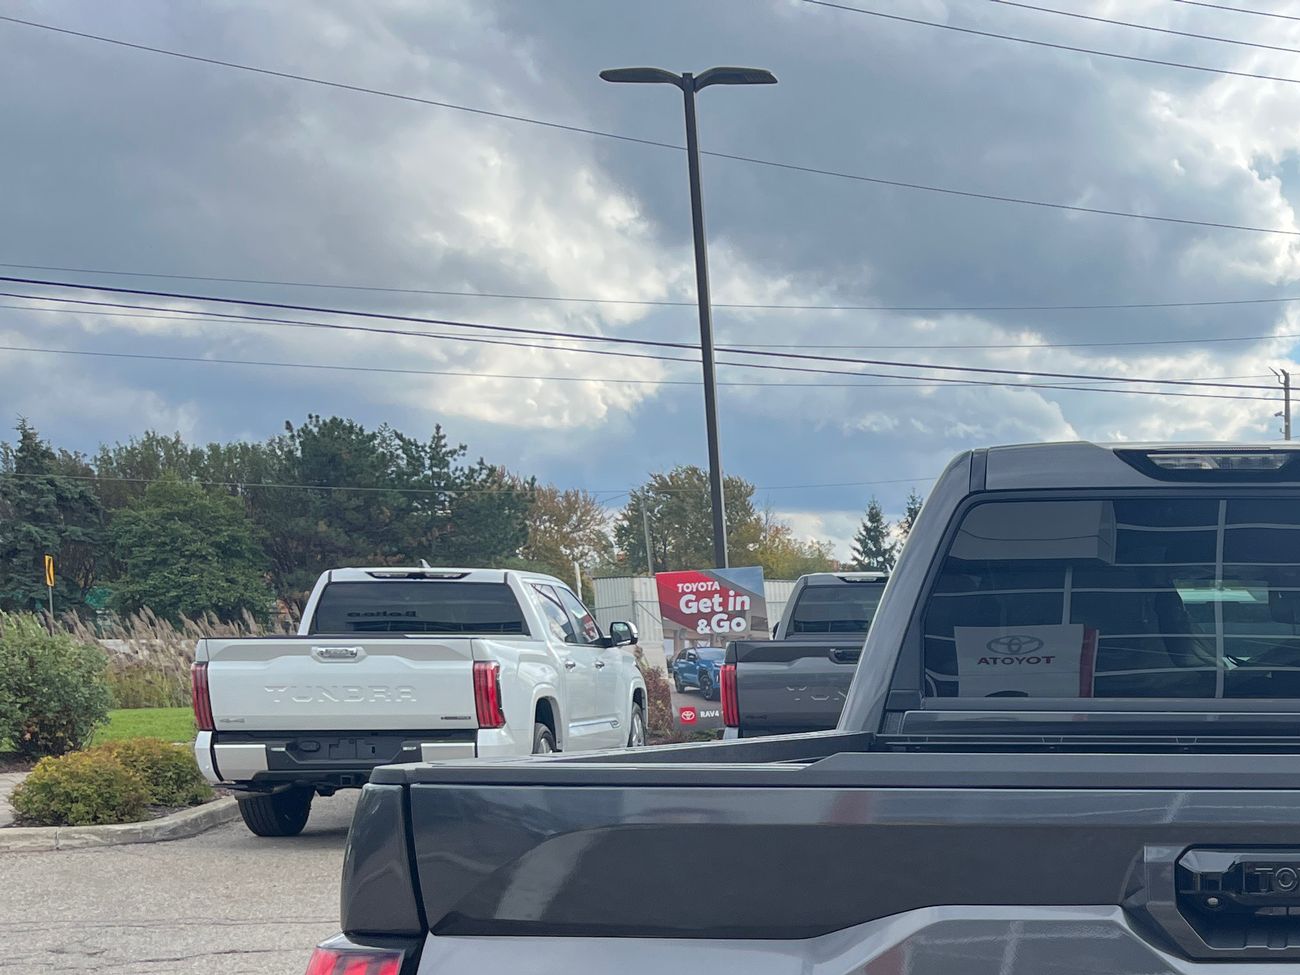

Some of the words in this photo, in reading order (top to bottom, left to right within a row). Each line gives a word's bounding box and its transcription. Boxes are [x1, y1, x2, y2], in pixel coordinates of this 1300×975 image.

[677, 581, 720, 593] TOYOTA
[679, 593, 723, 614] Get
[728, 590, 750, 611] in
[264, 685, 418, 703] TUNDRA
[700, 709, 720, 718] RAV4
